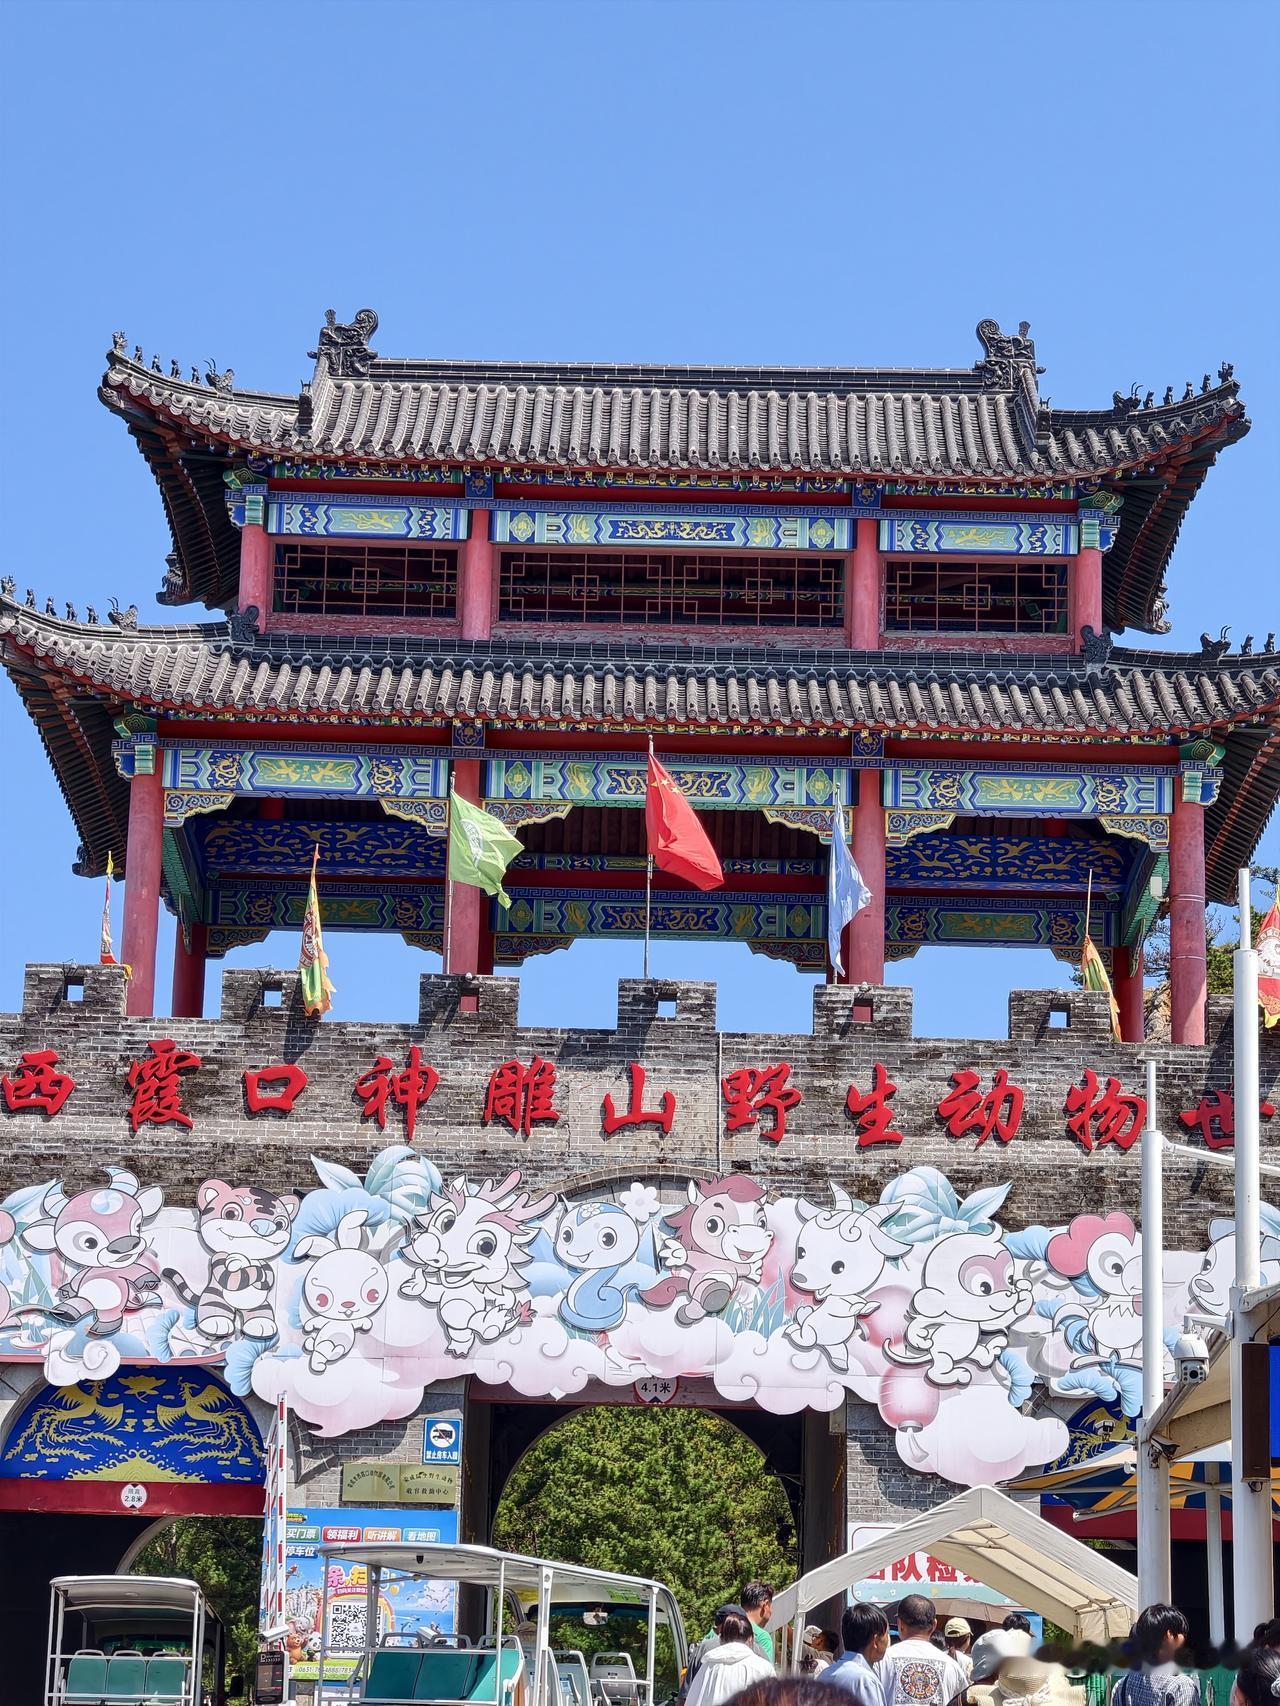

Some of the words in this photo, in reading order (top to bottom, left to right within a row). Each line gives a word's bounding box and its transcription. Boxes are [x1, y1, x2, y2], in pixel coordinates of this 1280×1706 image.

[641, 1382, 671, 1393] 4.1米
[124, 1495, 143, 1503] 2.8米
[327, 1529, 358, 1540] 领福利
[367, 1530, 397, 1541] 听讲解
[407, 1531, 437, 1542] 看地图
[866, 1552, 982, 1583] 队检
